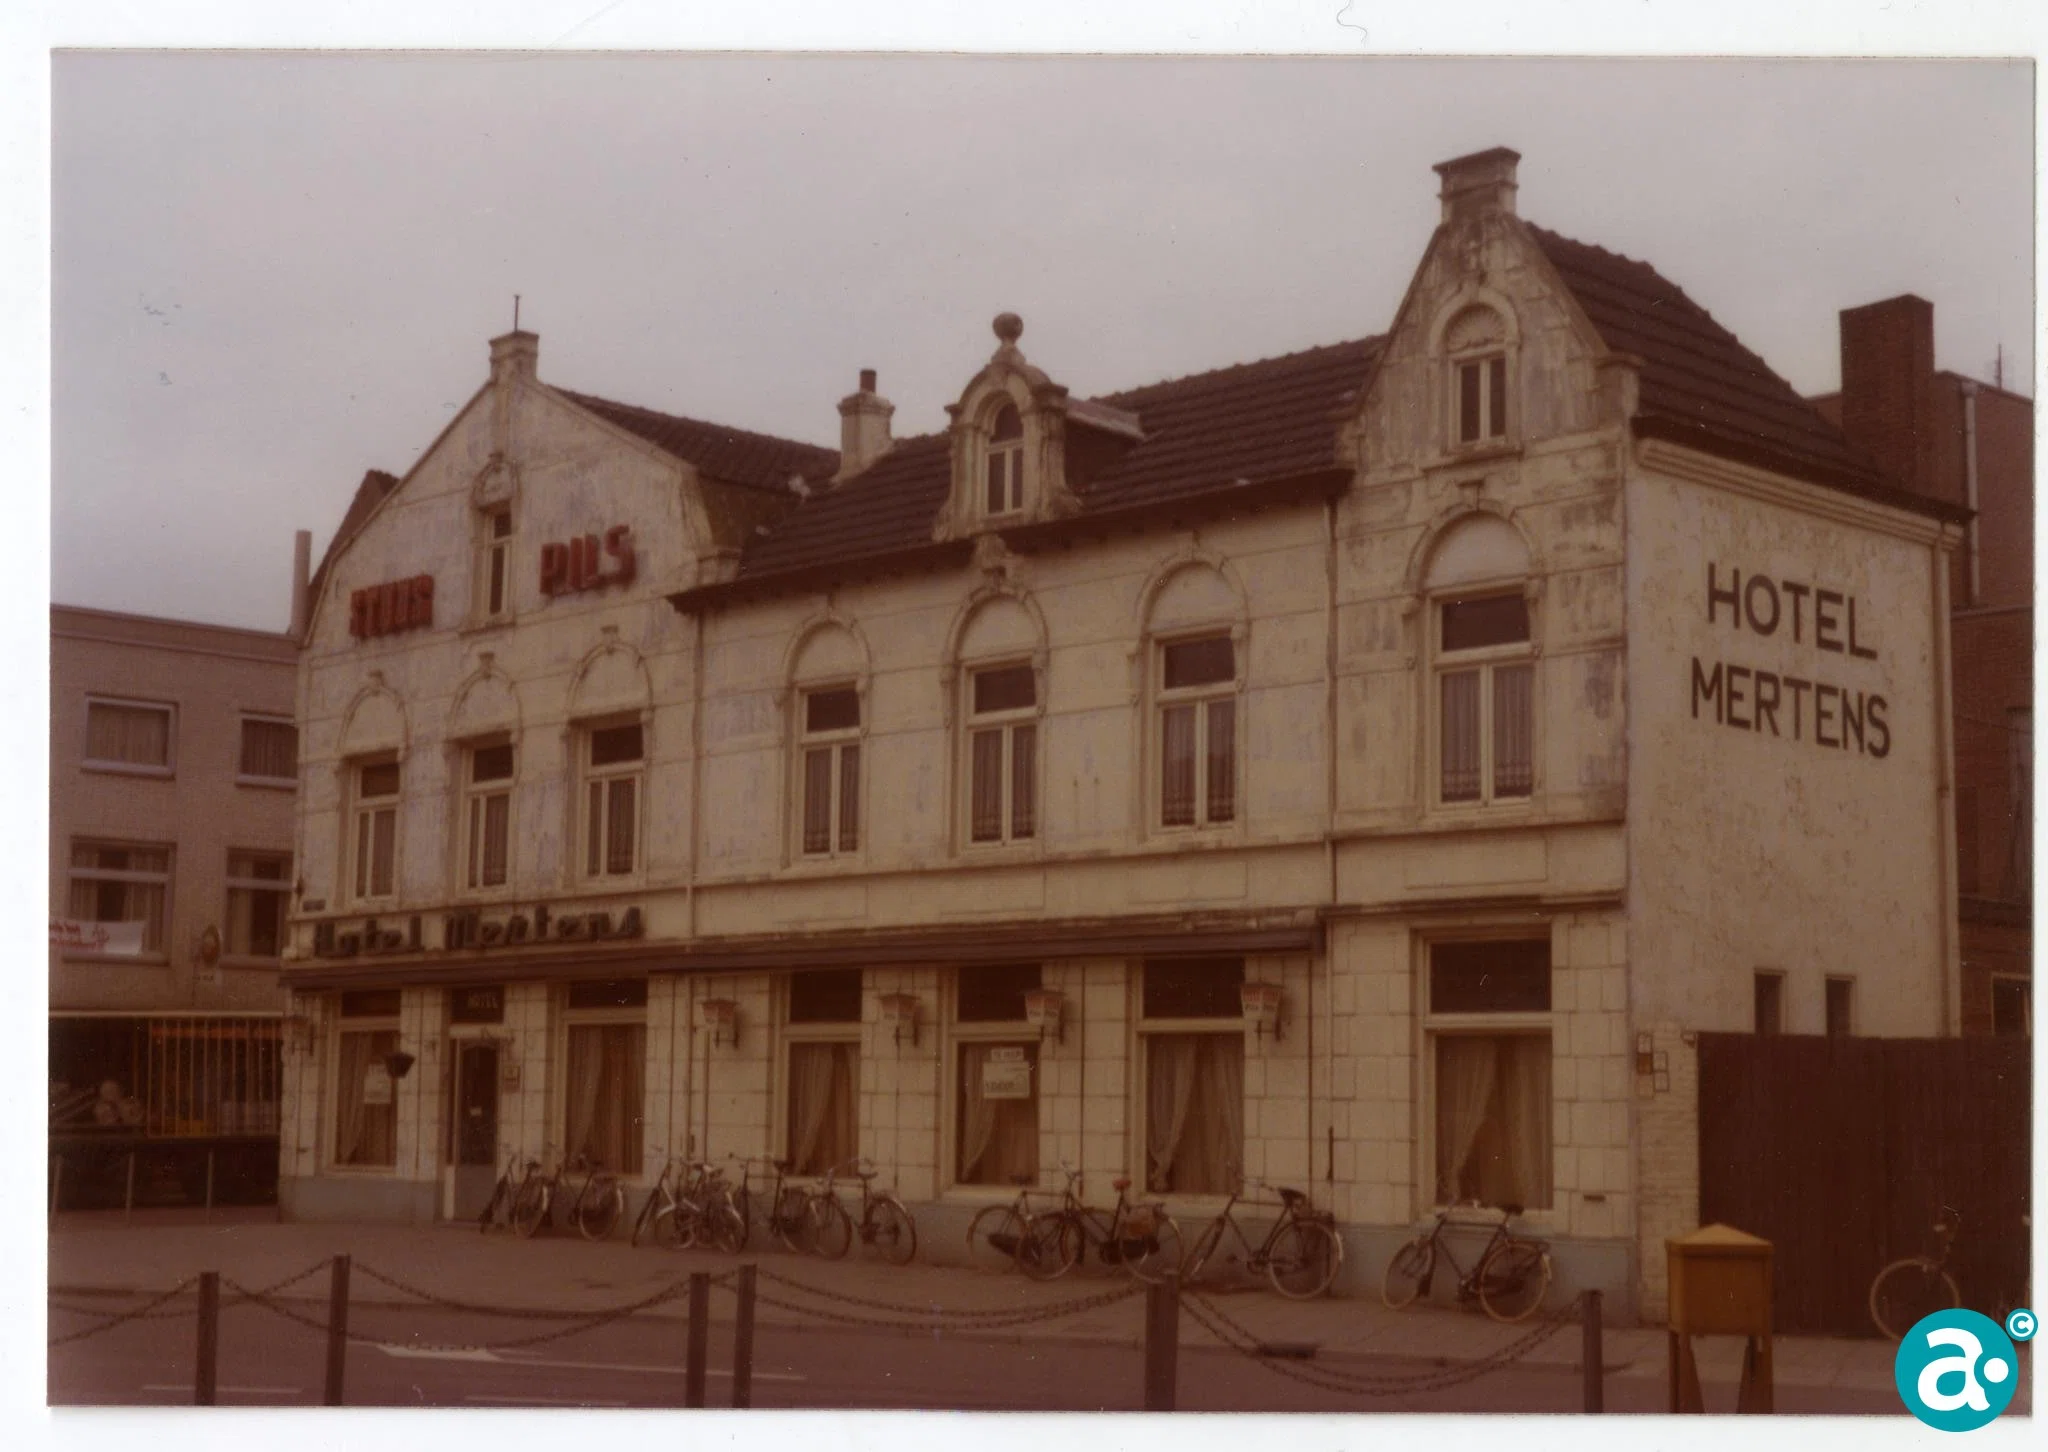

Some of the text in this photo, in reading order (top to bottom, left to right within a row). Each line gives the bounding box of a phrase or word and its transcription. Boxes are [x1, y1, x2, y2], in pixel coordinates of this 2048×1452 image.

[540, 525, 636, 596] PILS
[1708, 561, 1878, 661] HOTEL
[1691, 656, 1891, 759] MERTENS
